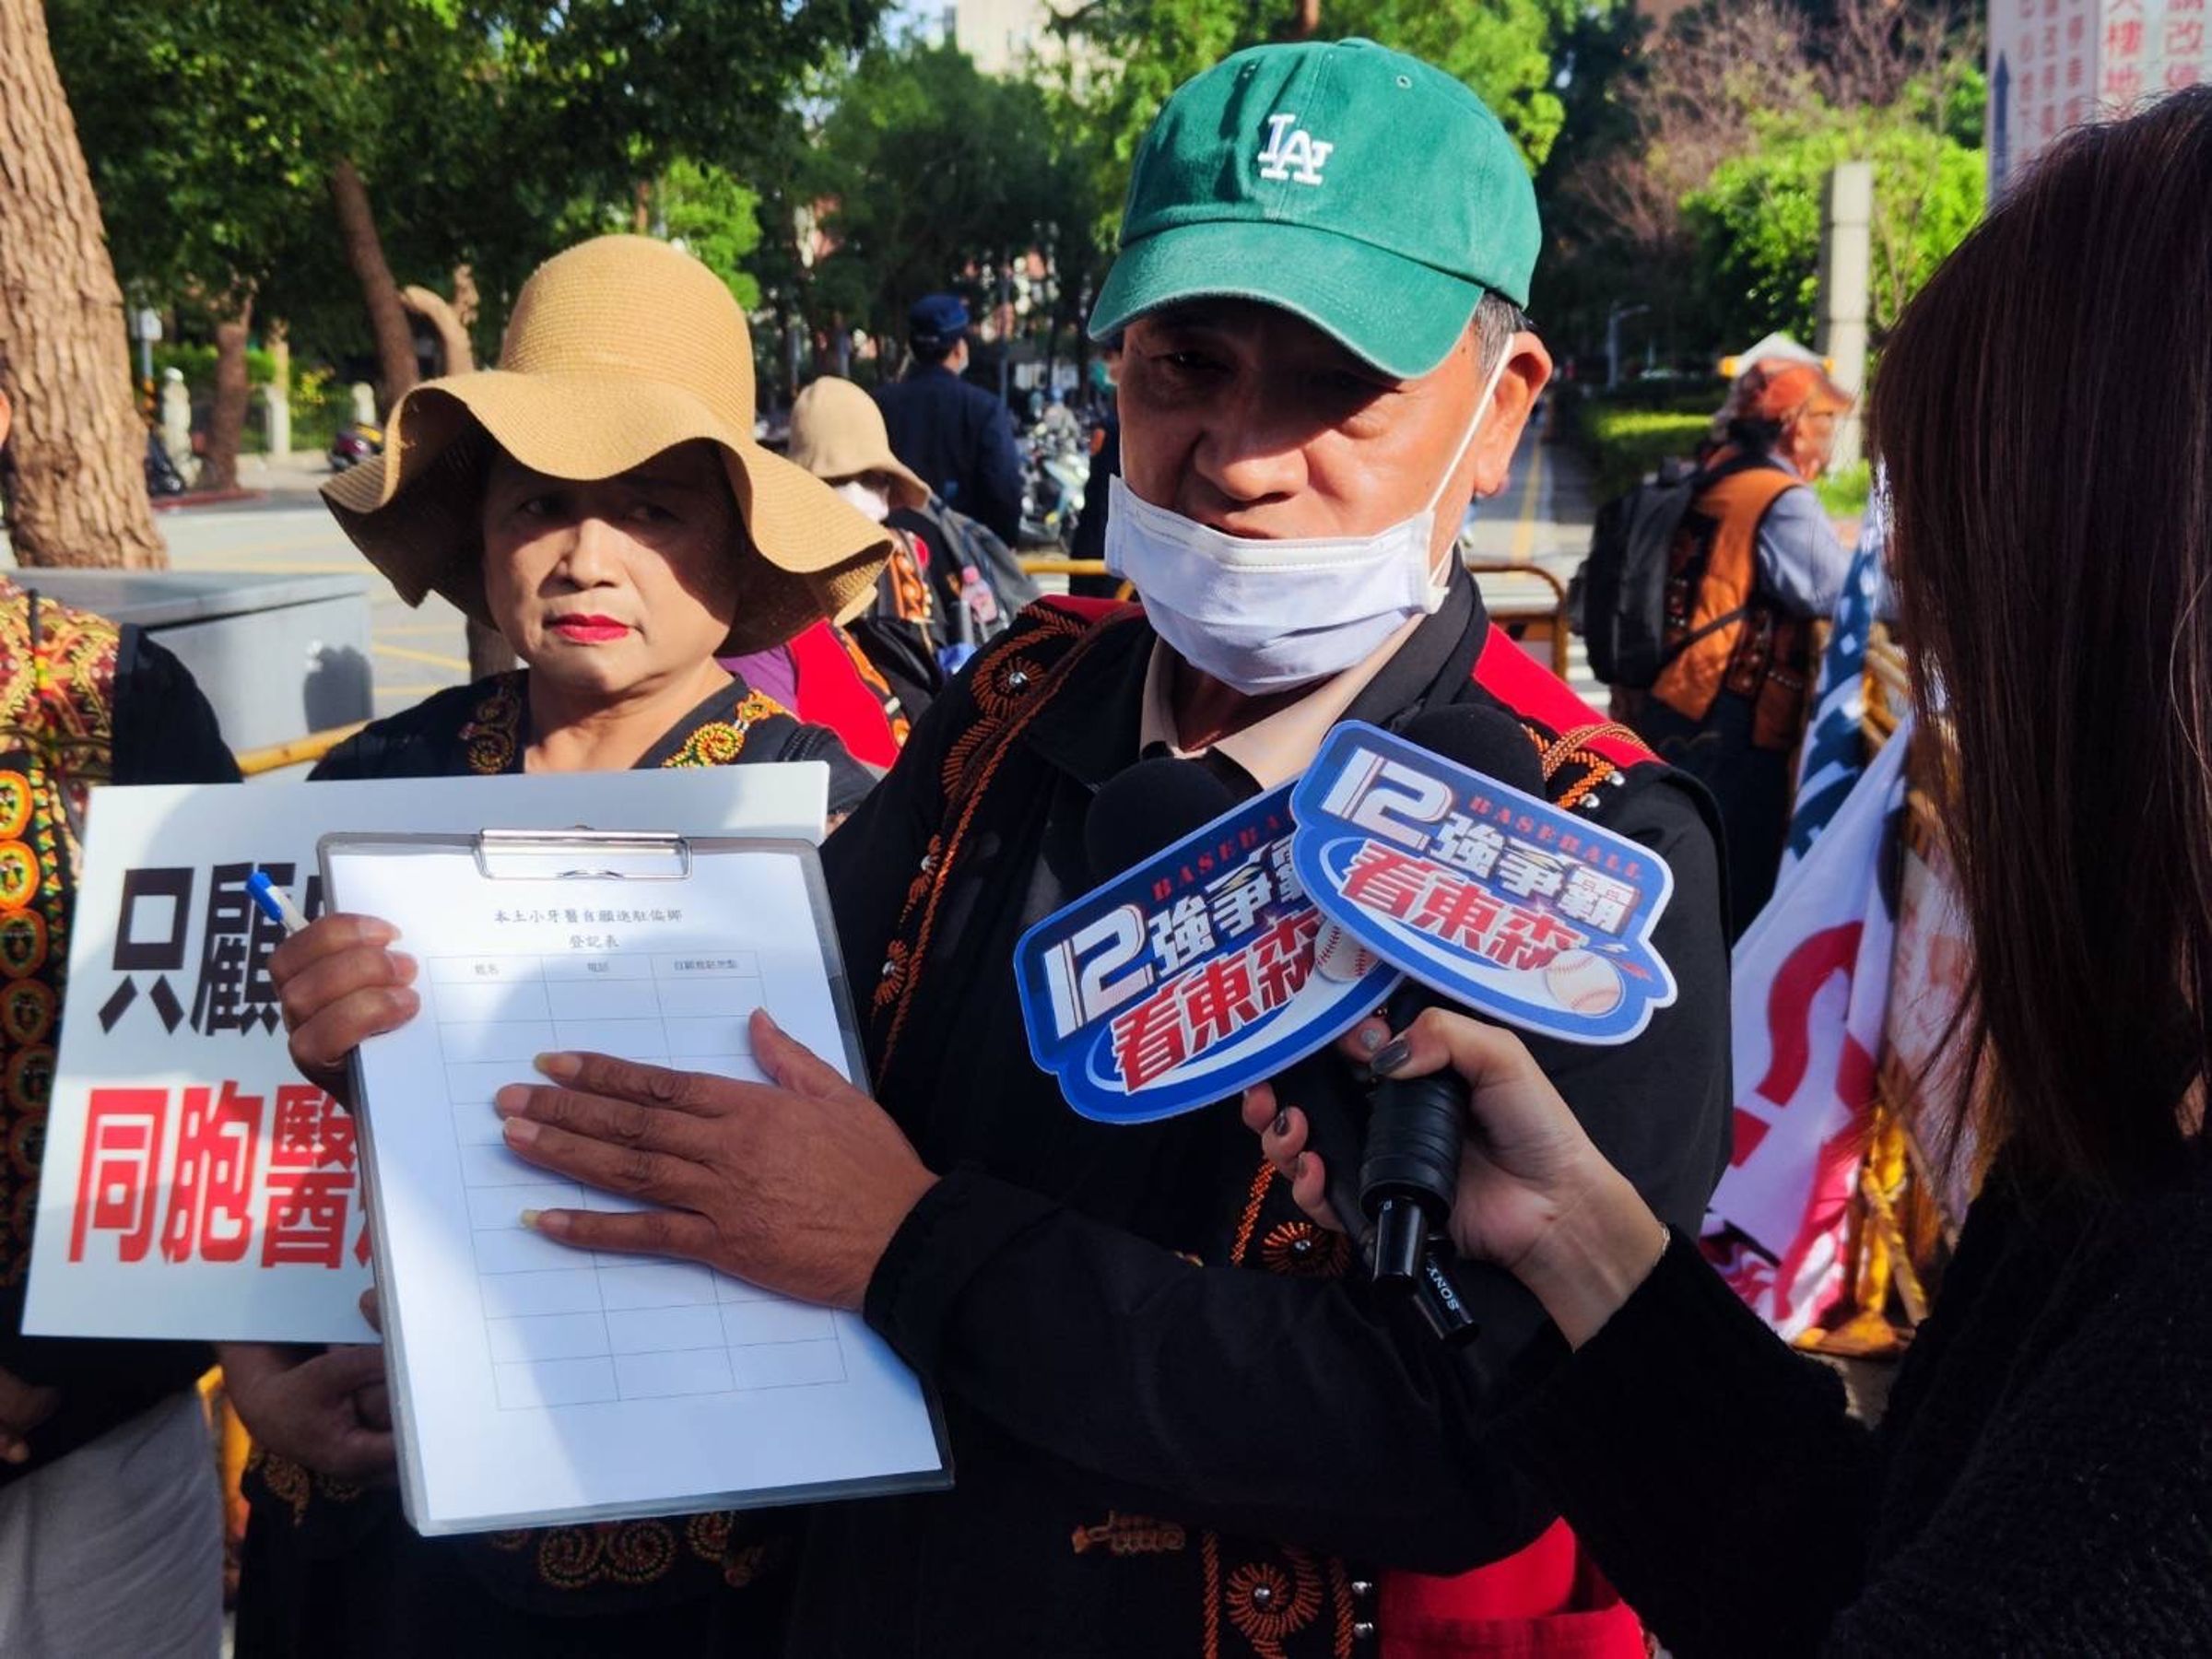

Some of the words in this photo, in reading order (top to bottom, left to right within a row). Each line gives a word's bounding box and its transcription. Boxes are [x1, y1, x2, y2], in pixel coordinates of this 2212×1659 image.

[1257, 113, 1334, 185] LA
[1152, 807, 1293, 900] BASEBA
[1322, 747, 1641, 934] 12強爭霸
[1468, 794, 1644, 882] BASEBALL
[99, 862, 324, 1036] 只顧
[569, 934, 619, 948] 登記表
[1338, 839, 1580, 971] 看東森
[68, 1080, 373, 1270] 同胞醫
[1426, 1265, 1460, 1311] SONY
